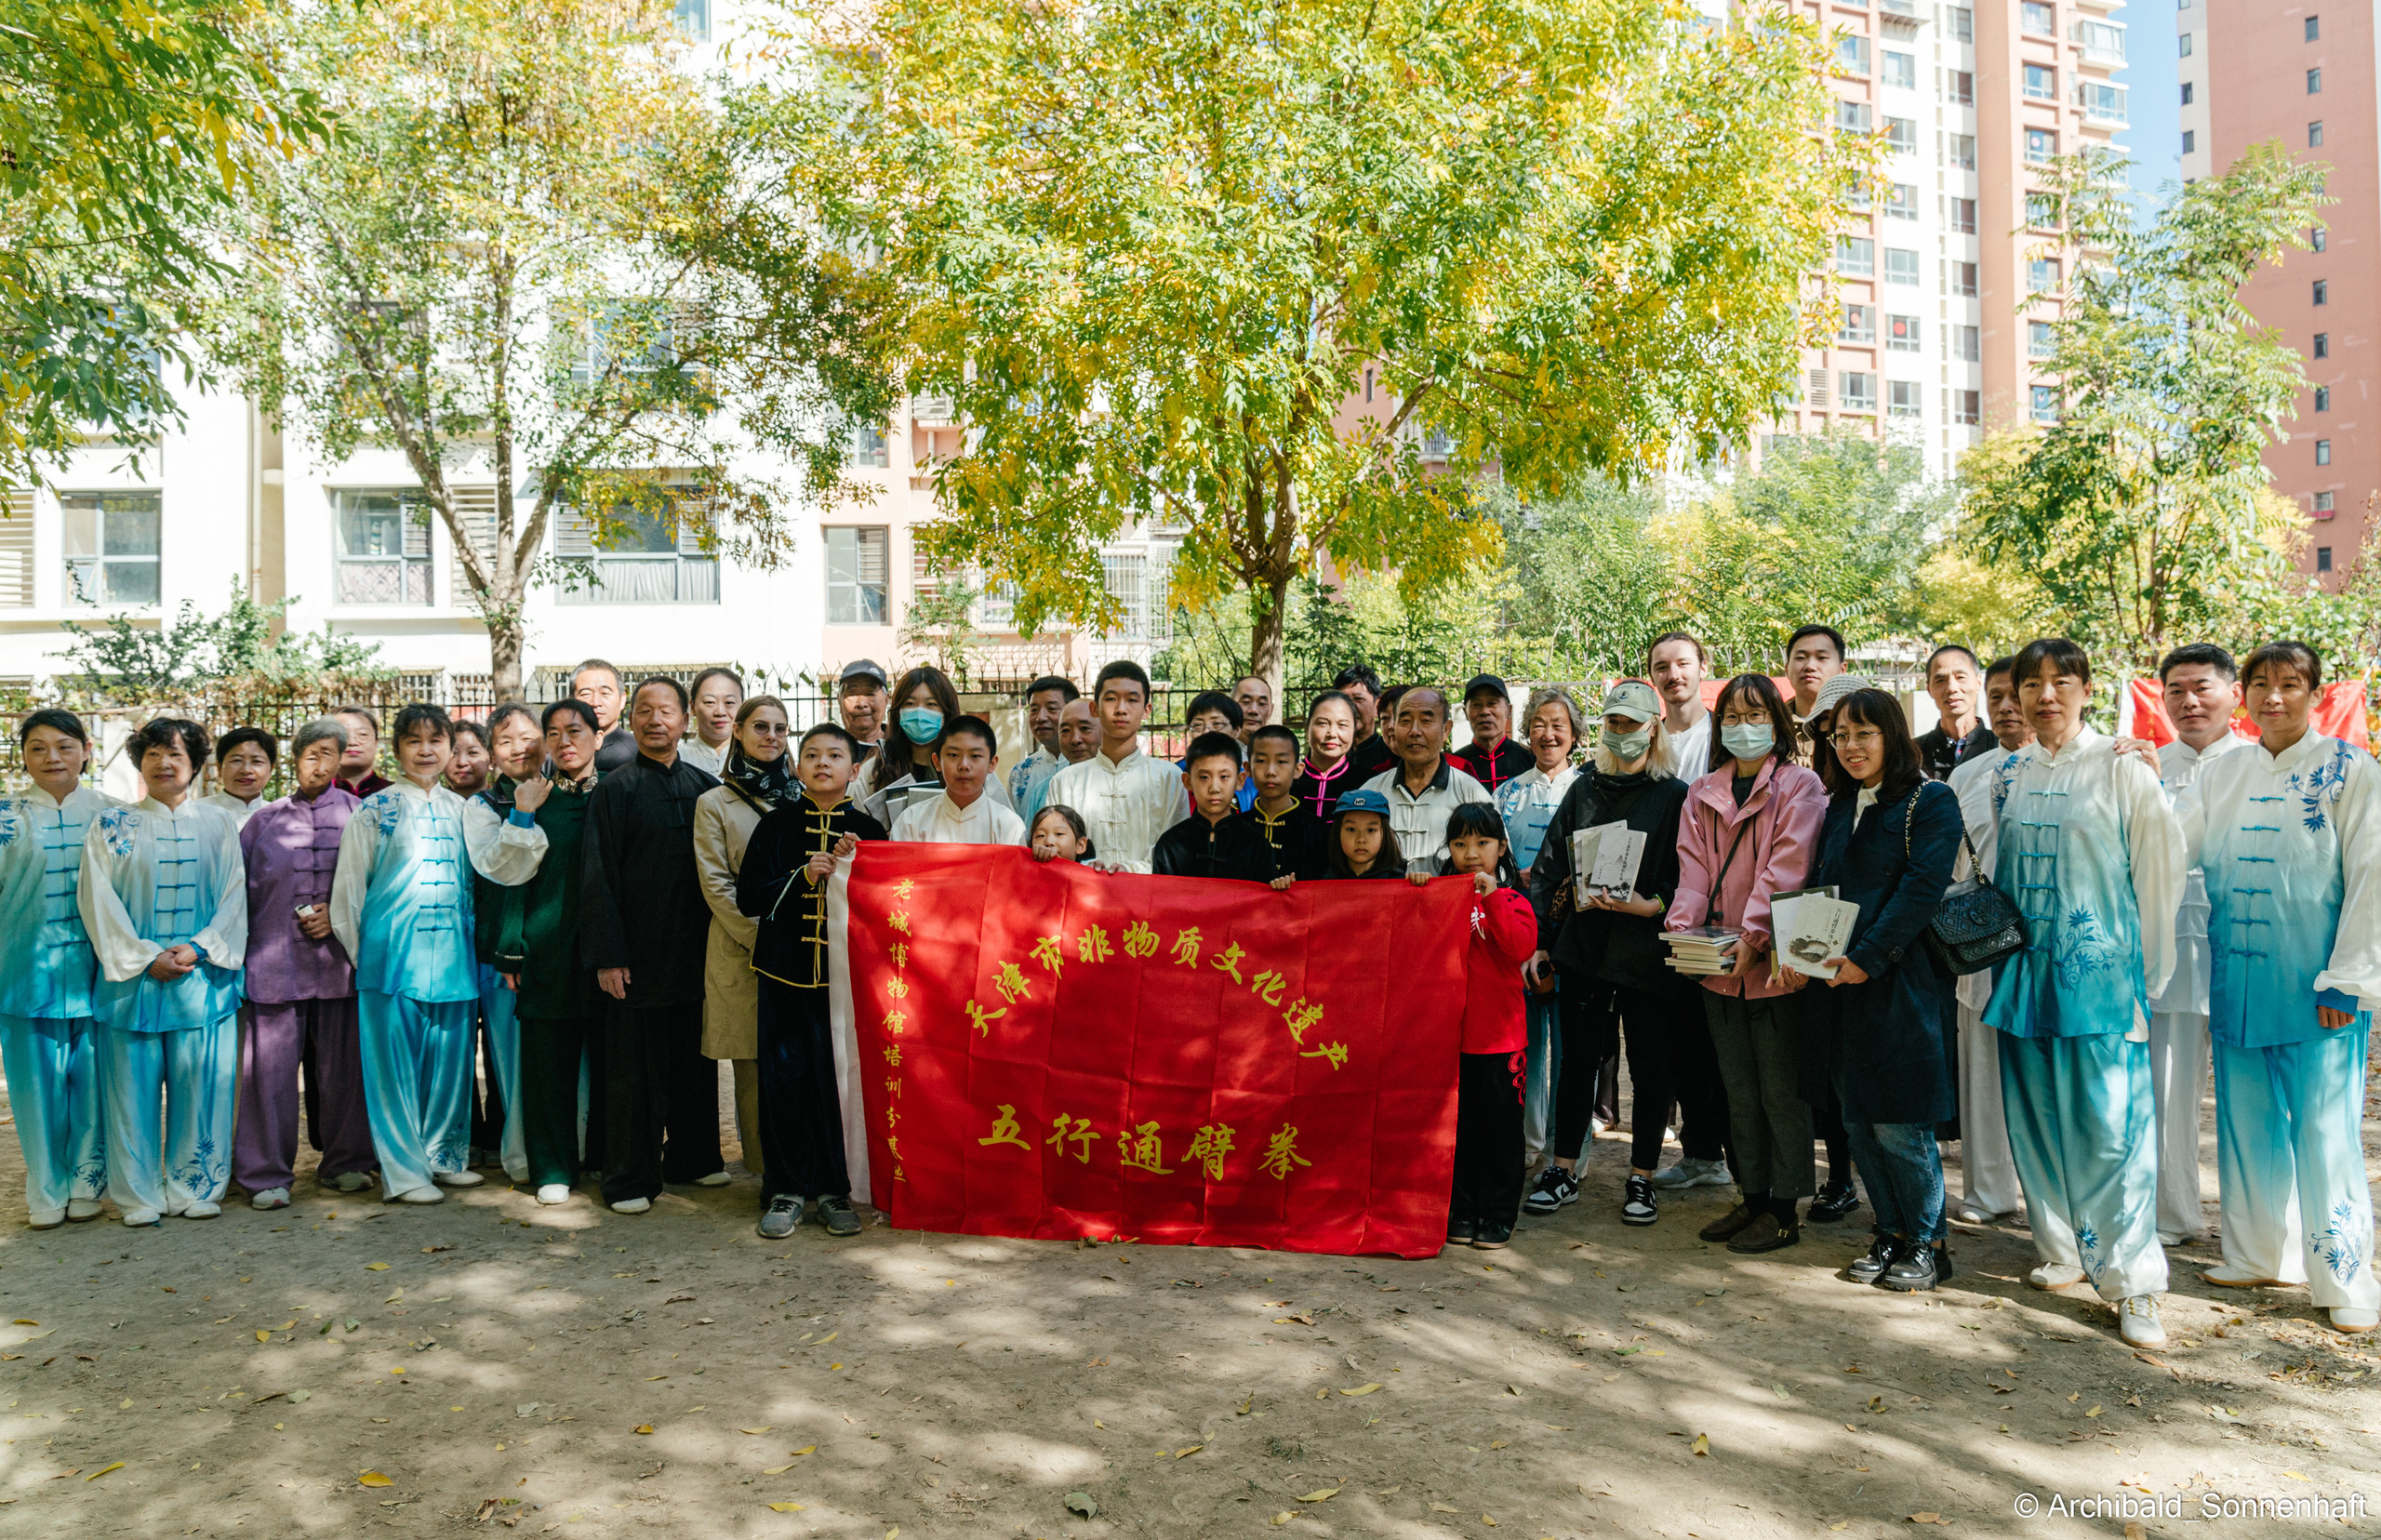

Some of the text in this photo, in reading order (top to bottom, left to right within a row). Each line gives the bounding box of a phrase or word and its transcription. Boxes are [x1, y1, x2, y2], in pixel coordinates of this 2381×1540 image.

[965, 921, 1349, 1070] 天津市非物质文化遗产
[978, 1104, 1312, 1181] 五行通臂拳
